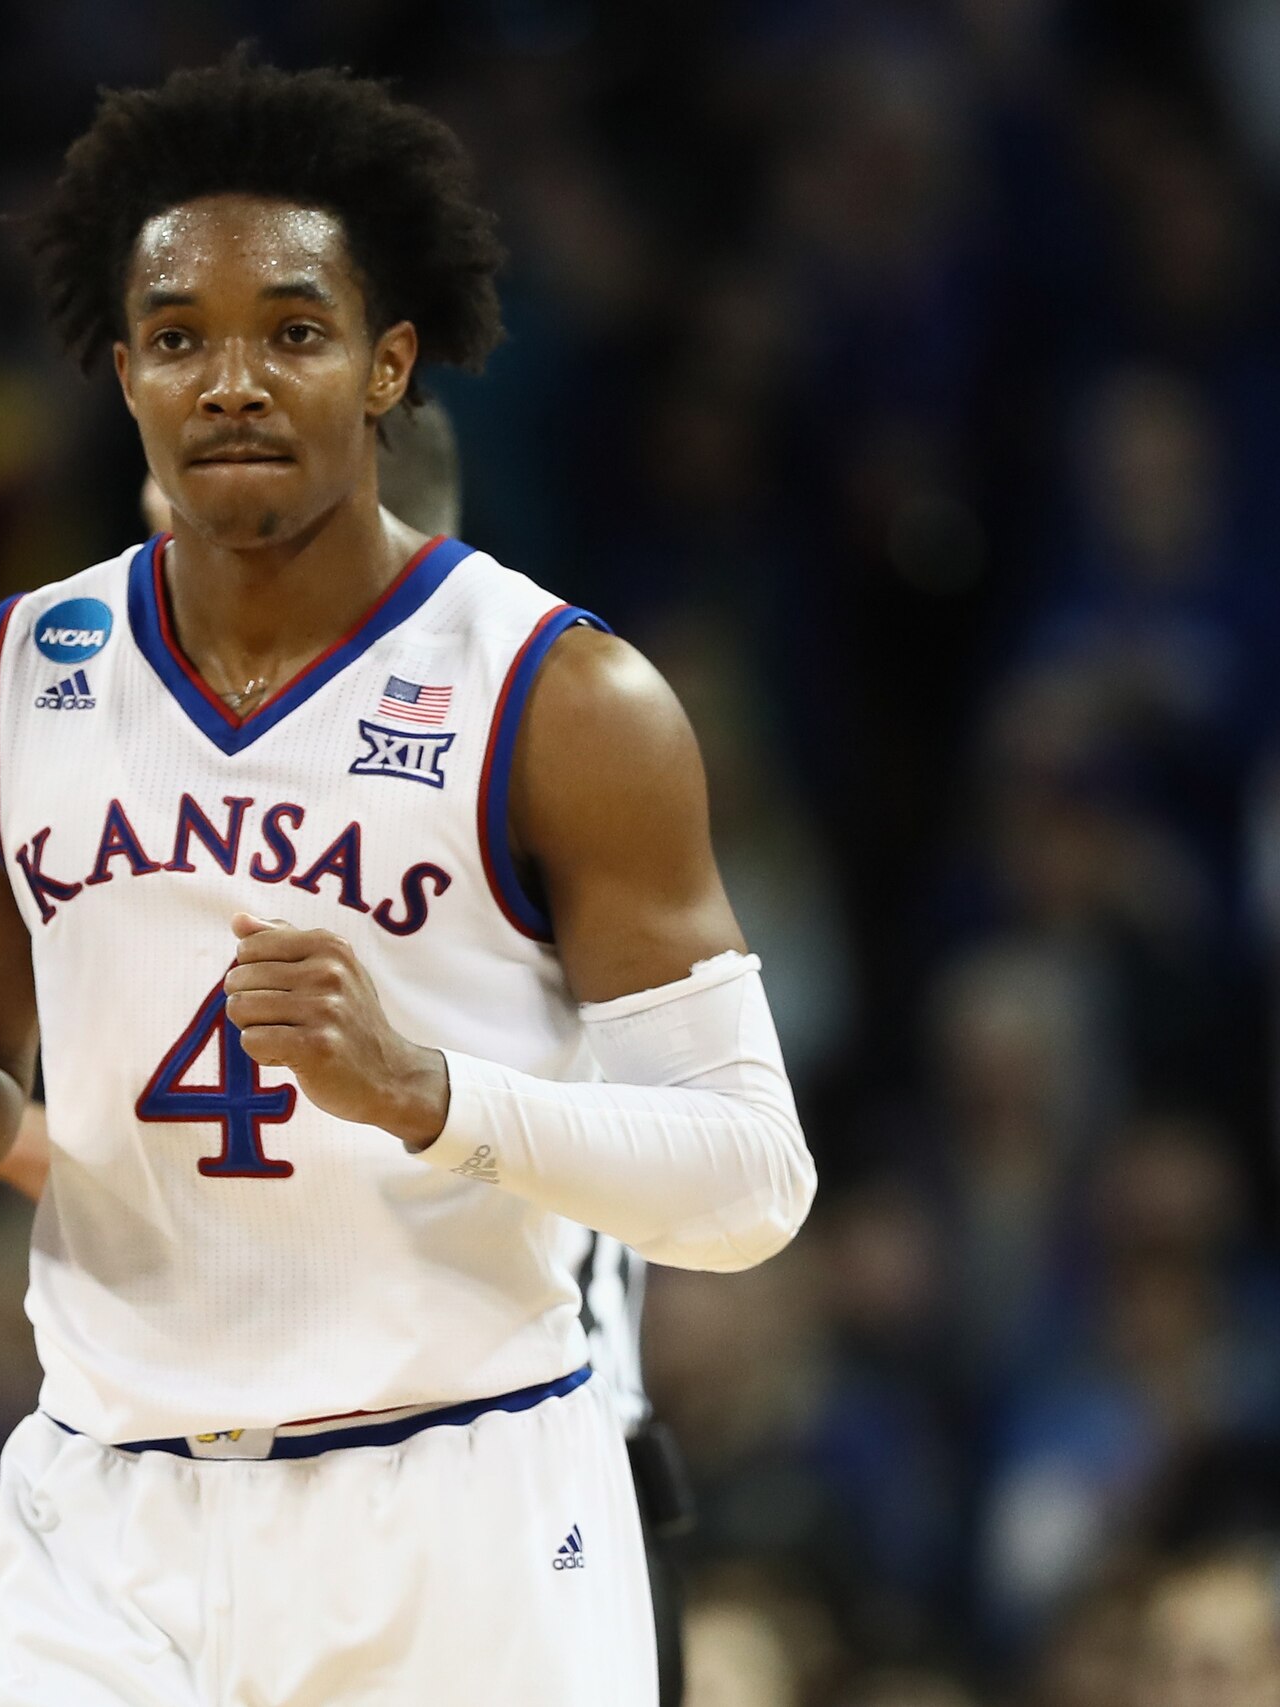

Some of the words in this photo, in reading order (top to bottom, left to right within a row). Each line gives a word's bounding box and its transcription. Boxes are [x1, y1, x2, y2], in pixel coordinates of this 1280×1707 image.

[40, 627, 104, 648] NCAA
[35, 694, 96, 710] adidas
[350, 721, 454, 786] XII
[16, 793, 451, 936] KANSAS
[135, 957, 297, 1178] 4
